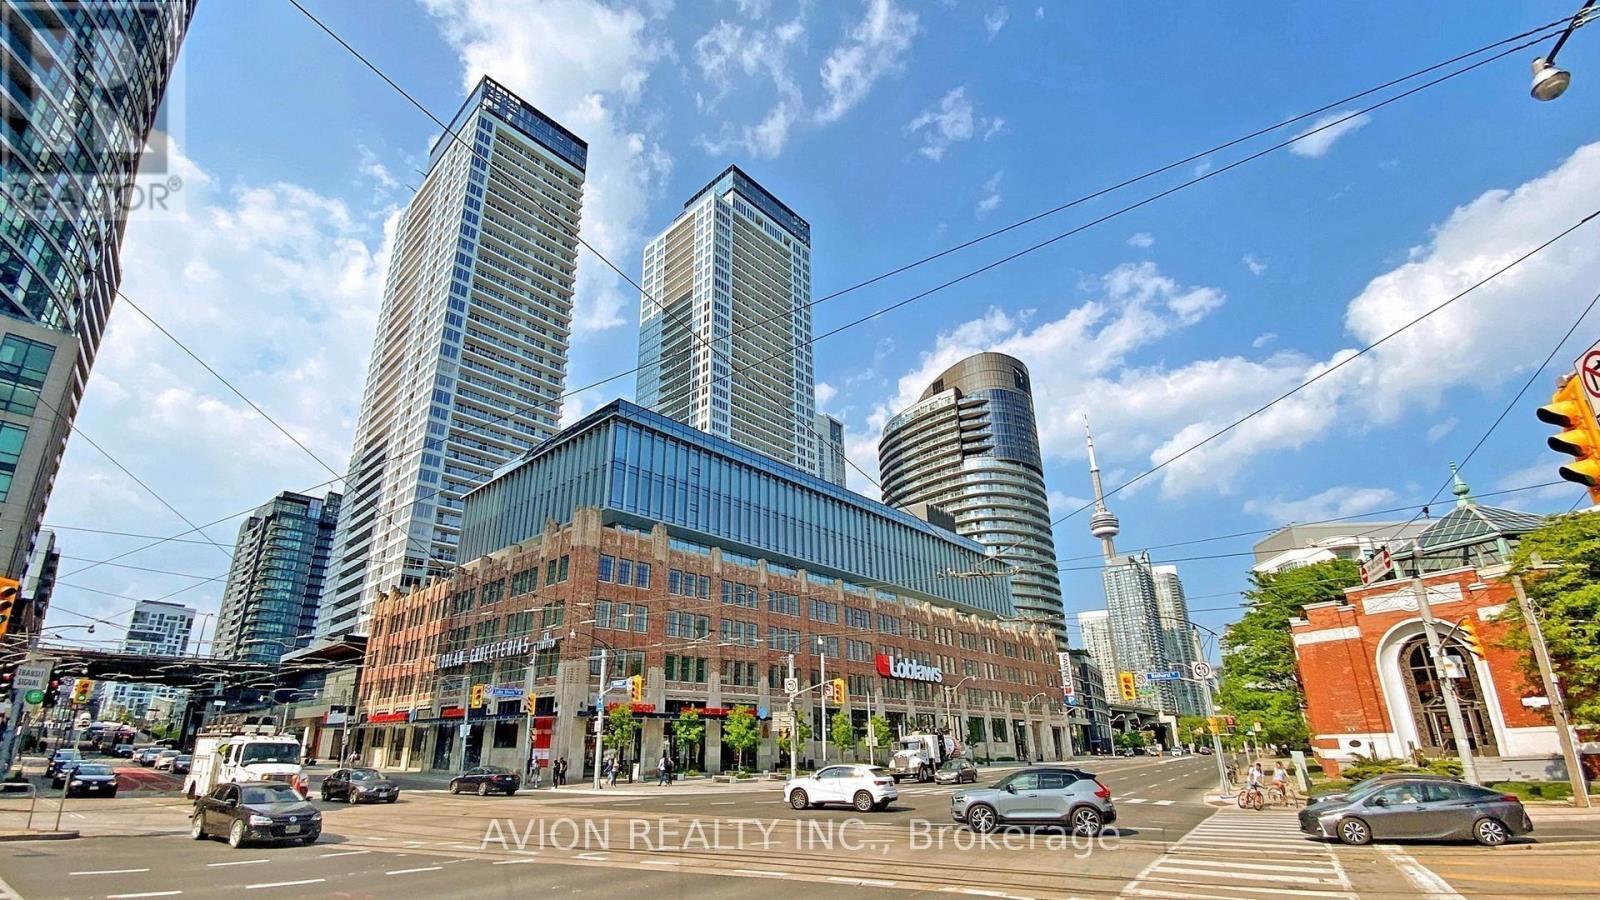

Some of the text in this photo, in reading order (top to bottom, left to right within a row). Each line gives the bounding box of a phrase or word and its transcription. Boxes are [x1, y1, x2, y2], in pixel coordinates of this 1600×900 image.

[18, 669, 44, 677] TRANSIT
[889, 655, 943, 683] Loblaws
[1063, 654, 1072, 687] Loblaws
[17, 679, 39, 687] SIGNAL
